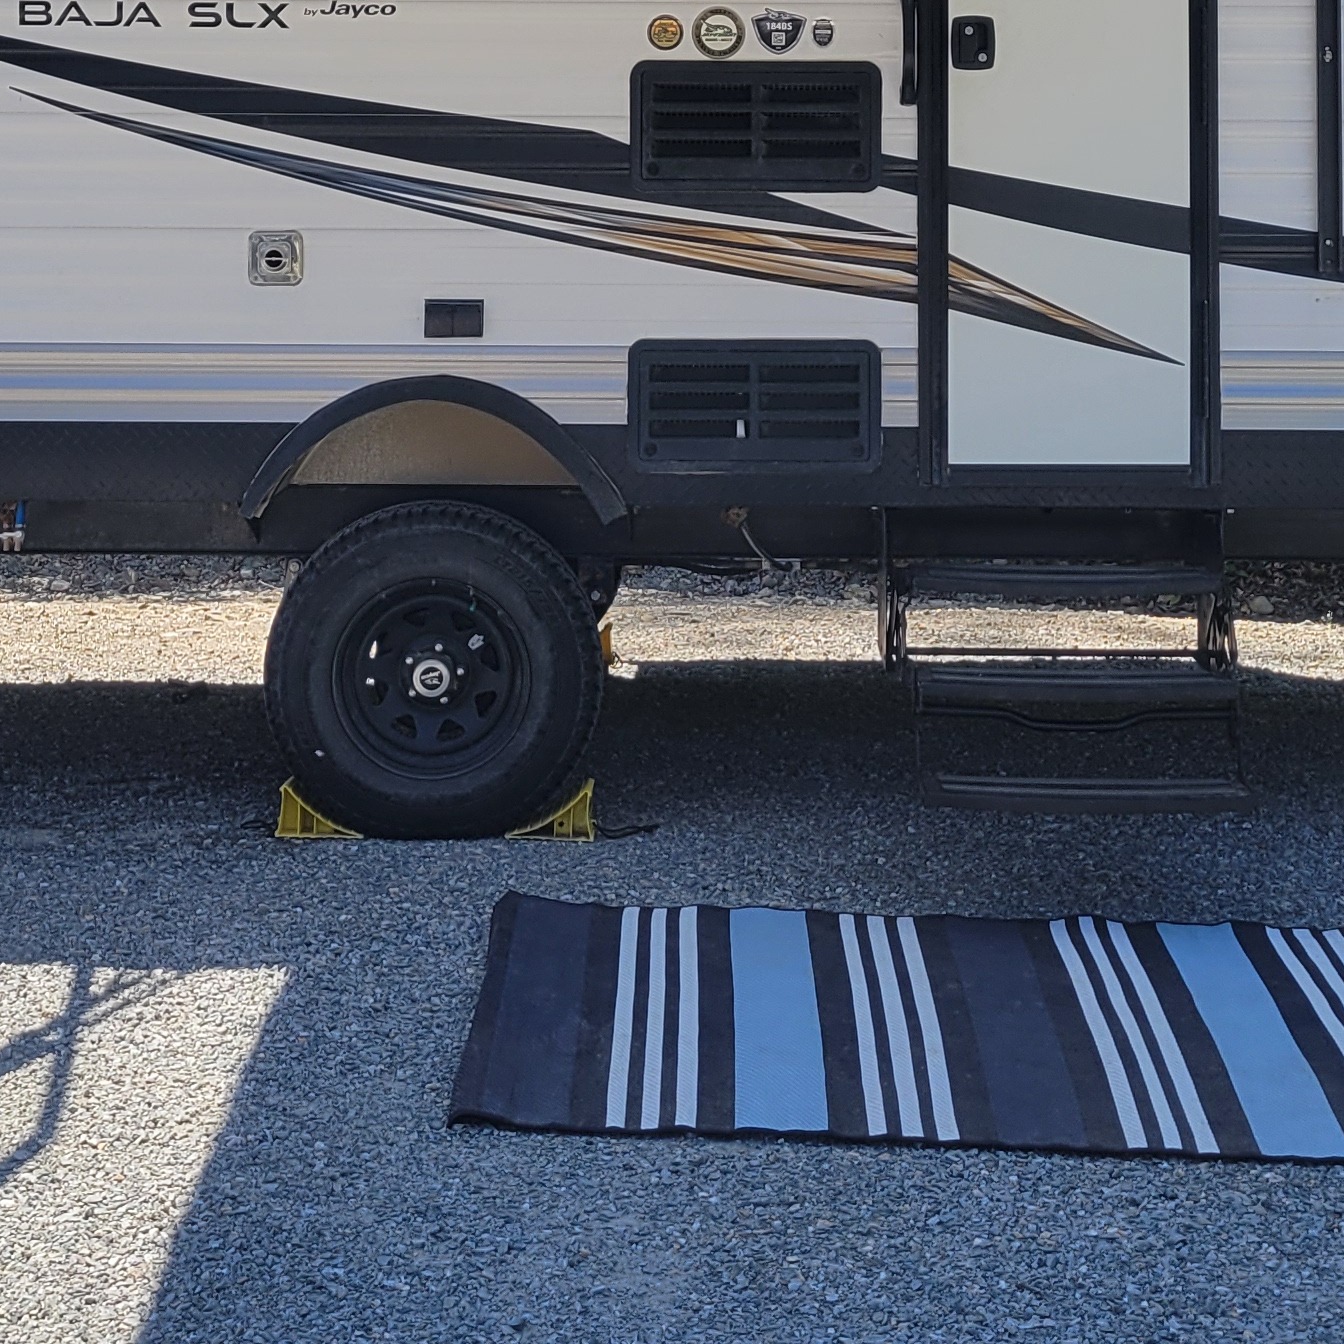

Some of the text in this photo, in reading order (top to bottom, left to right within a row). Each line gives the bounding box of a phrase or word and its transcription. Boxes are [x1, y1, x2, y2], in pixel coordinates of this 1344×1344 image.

[18, 0, 397, 29] BAJA SLX by Jayco
